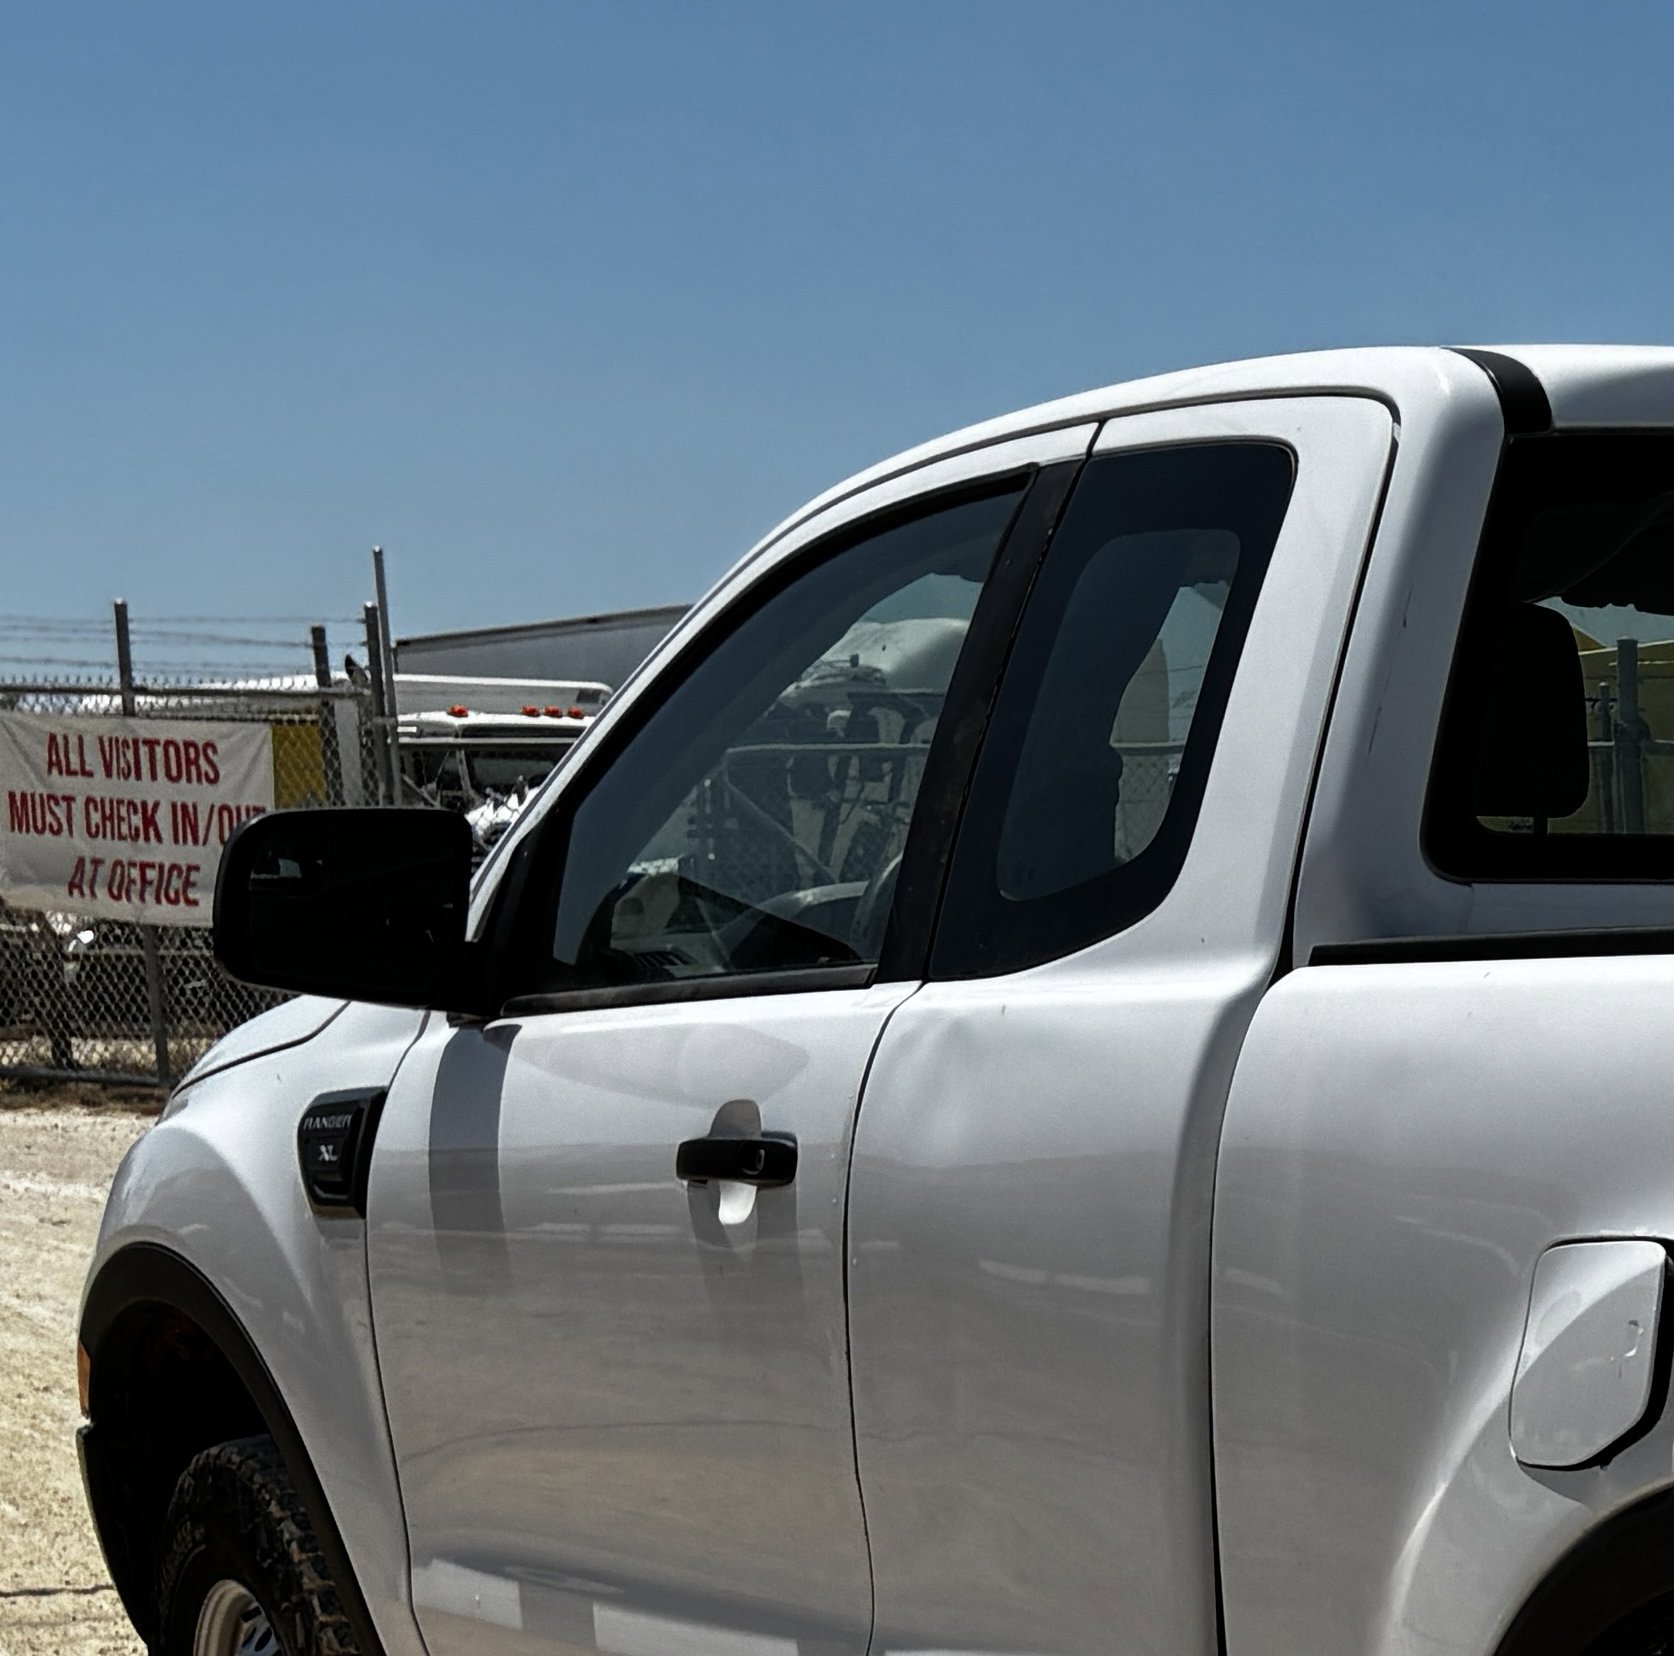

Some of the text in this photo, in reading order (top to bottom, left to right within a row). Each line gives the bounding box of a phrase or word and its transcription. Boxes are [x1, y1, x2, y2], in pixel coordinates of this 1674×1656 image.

[47, 732, 220, 785] ALL VISITORS
[8, 791, 266, 847] MUST CHECK IN/O
[68, 856, 200, 906] AT OFFICE
[303, 1114, 353, 1131] RANGER
[318, 1144, 338, 1162] XL
